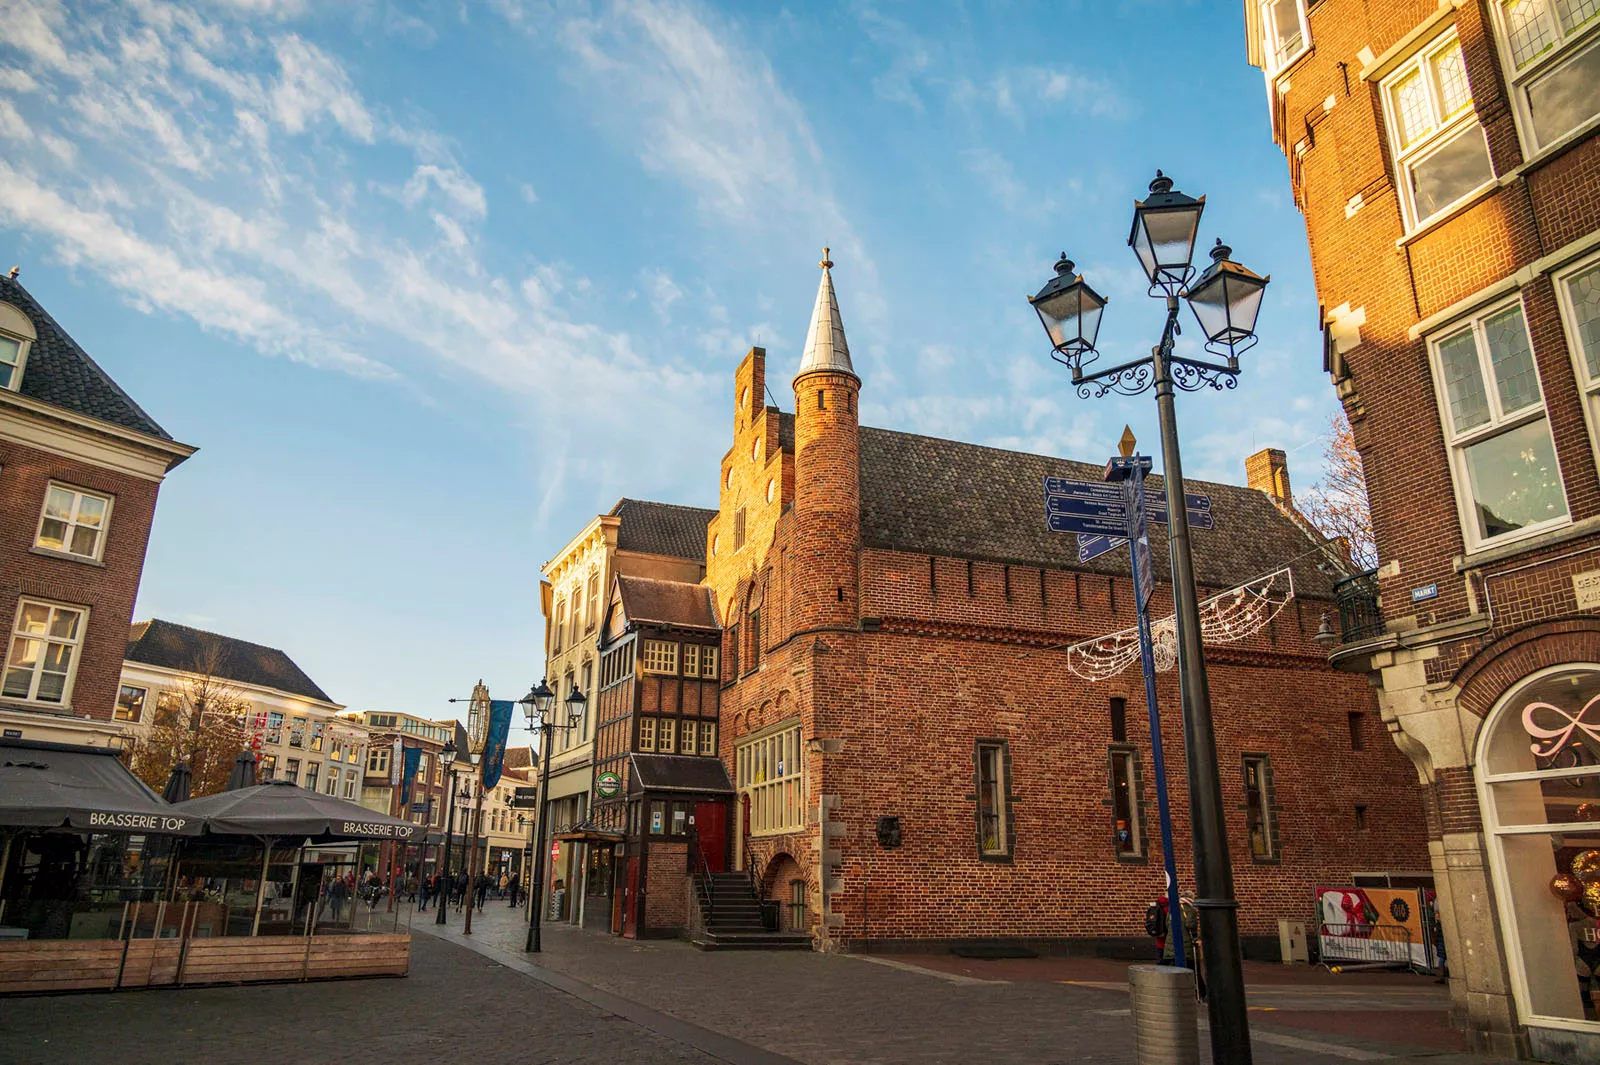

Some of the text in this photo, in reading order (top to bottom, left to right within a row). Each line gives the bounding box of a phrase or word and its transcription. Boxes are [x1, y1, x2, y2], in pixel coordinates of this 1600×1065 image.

[1415, 587, 1435, 598] MARKT
[90, 812, 186, 831] BRASSERIE TOP
[343, 821, 414, 837] BRASSERIE TOP
